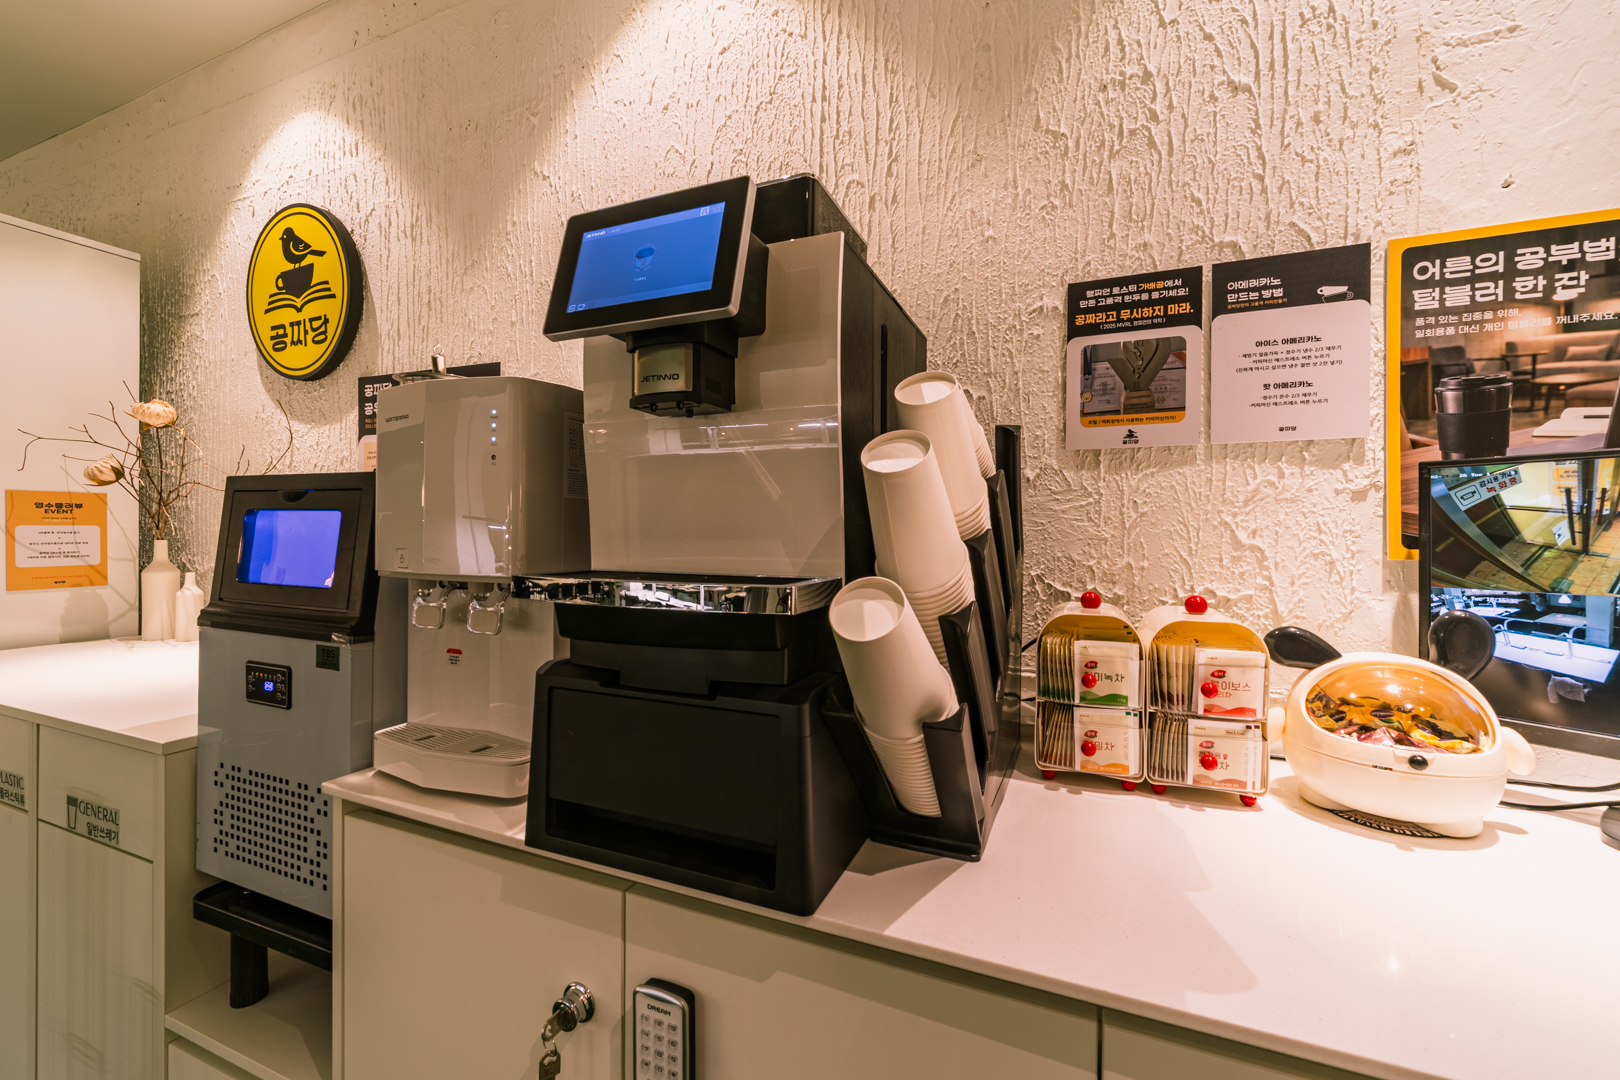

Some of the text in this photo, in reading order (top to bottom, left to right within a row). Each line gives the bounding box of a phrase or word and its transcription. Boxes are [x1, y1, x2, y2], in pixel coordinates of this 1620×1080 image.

[1412, 236, 1620, 281] 어른의 공부법
[1086, 288, 1111, 298] 챔피언
[1111, 284, 1137, 295] 로스터
[1227, 276, 1282, 291] 아메리카노
[1079, 287, 1189, 308] 만든 고품격 원두를 즐기세요!
[1227, 287, 1284, 303] 만드는 방법
[1412, 280, 1505, 310] 텀블러
[1512, 275, 1547, 300] 한
[1075, 302, 1194, 326] 공짜라고 무시하지 마라.
[1415, 316, 1436, 327] 품격
[1438, 314, 1460, 324] 있는
[1462, 311, 1494, 322] 집중을
[1414, 311, 1619, 338] 일회용품 대신 개인 텀블러를 꺼내주세요.
[270, 314, 329, 352] 공짜당
[1255, 335, 1322, 347] 아이스 아메리카노
[641, 373, 680, 383] JETINNO
[1262, 380, 1314, 391] 핫 아메리카노
[321, 648, 336, 659] TBS
[1084, 672, 1126, 683] 미녹차
[0, 771, 25, 790] LASTIC
[78, 800, 120, 826] GENERAL
[86, 821, 119, 845] 일반쓰레기
[647, 1004, 671, 1017] DREAM
